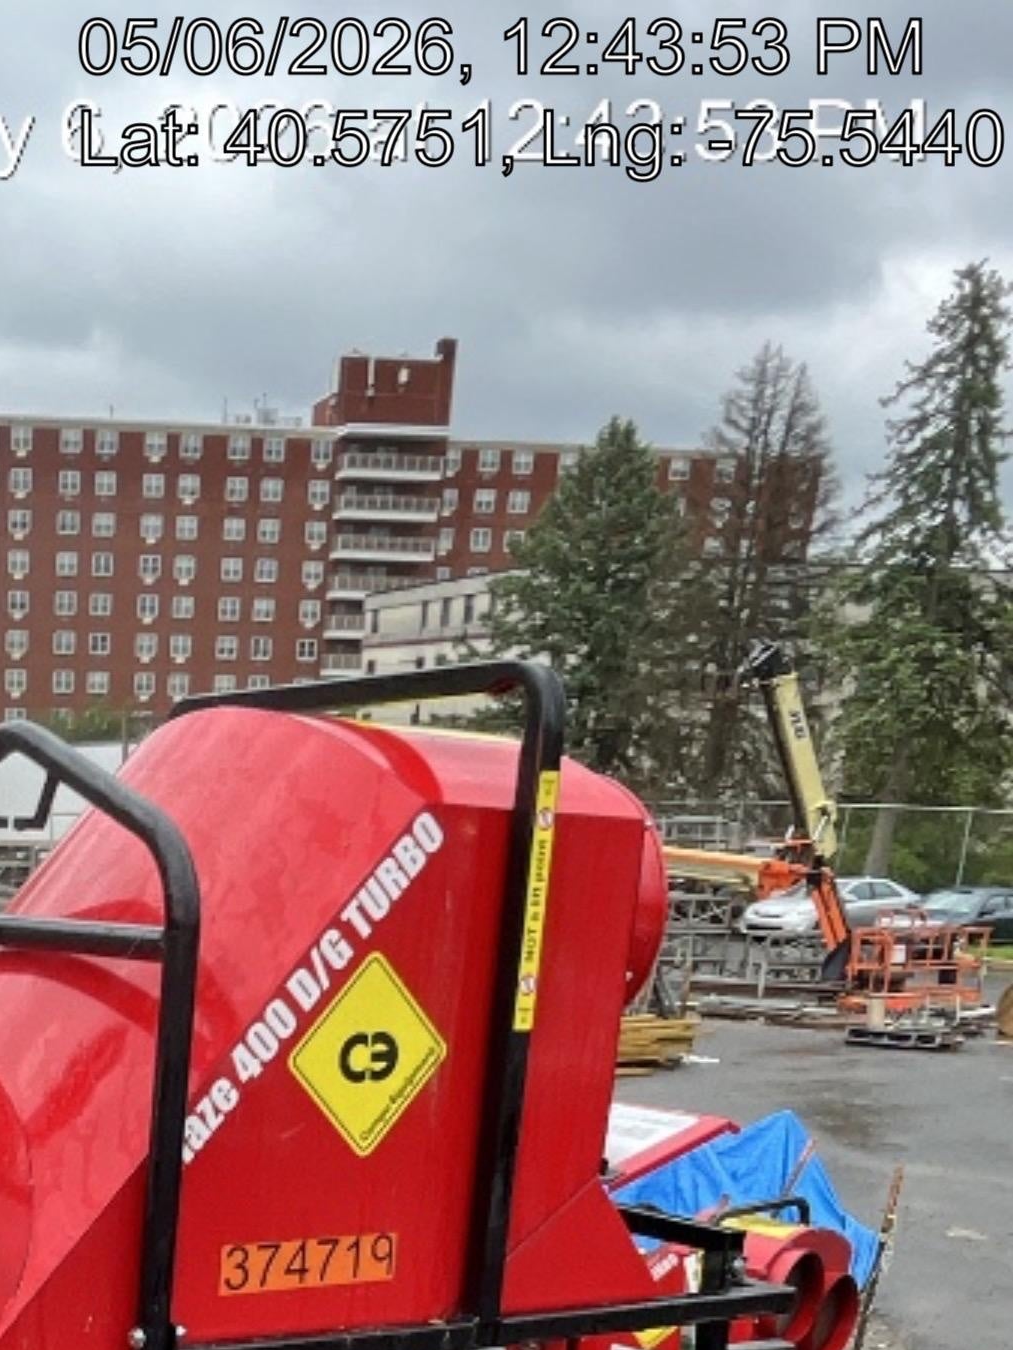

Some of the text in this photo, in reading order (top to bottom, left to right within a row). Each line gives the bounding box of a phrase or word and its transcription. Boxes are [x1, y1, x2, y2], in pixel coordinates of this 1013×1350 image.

[231, 998, 297, 1083] 400
[286, 929, 355, 1012] D/G
[341, 812, 445, 939] TURBO
[524, 925, 538, 962] NOT
[535, 838, 549, 883] point
[224, 1234, 393, 1291] 374719
